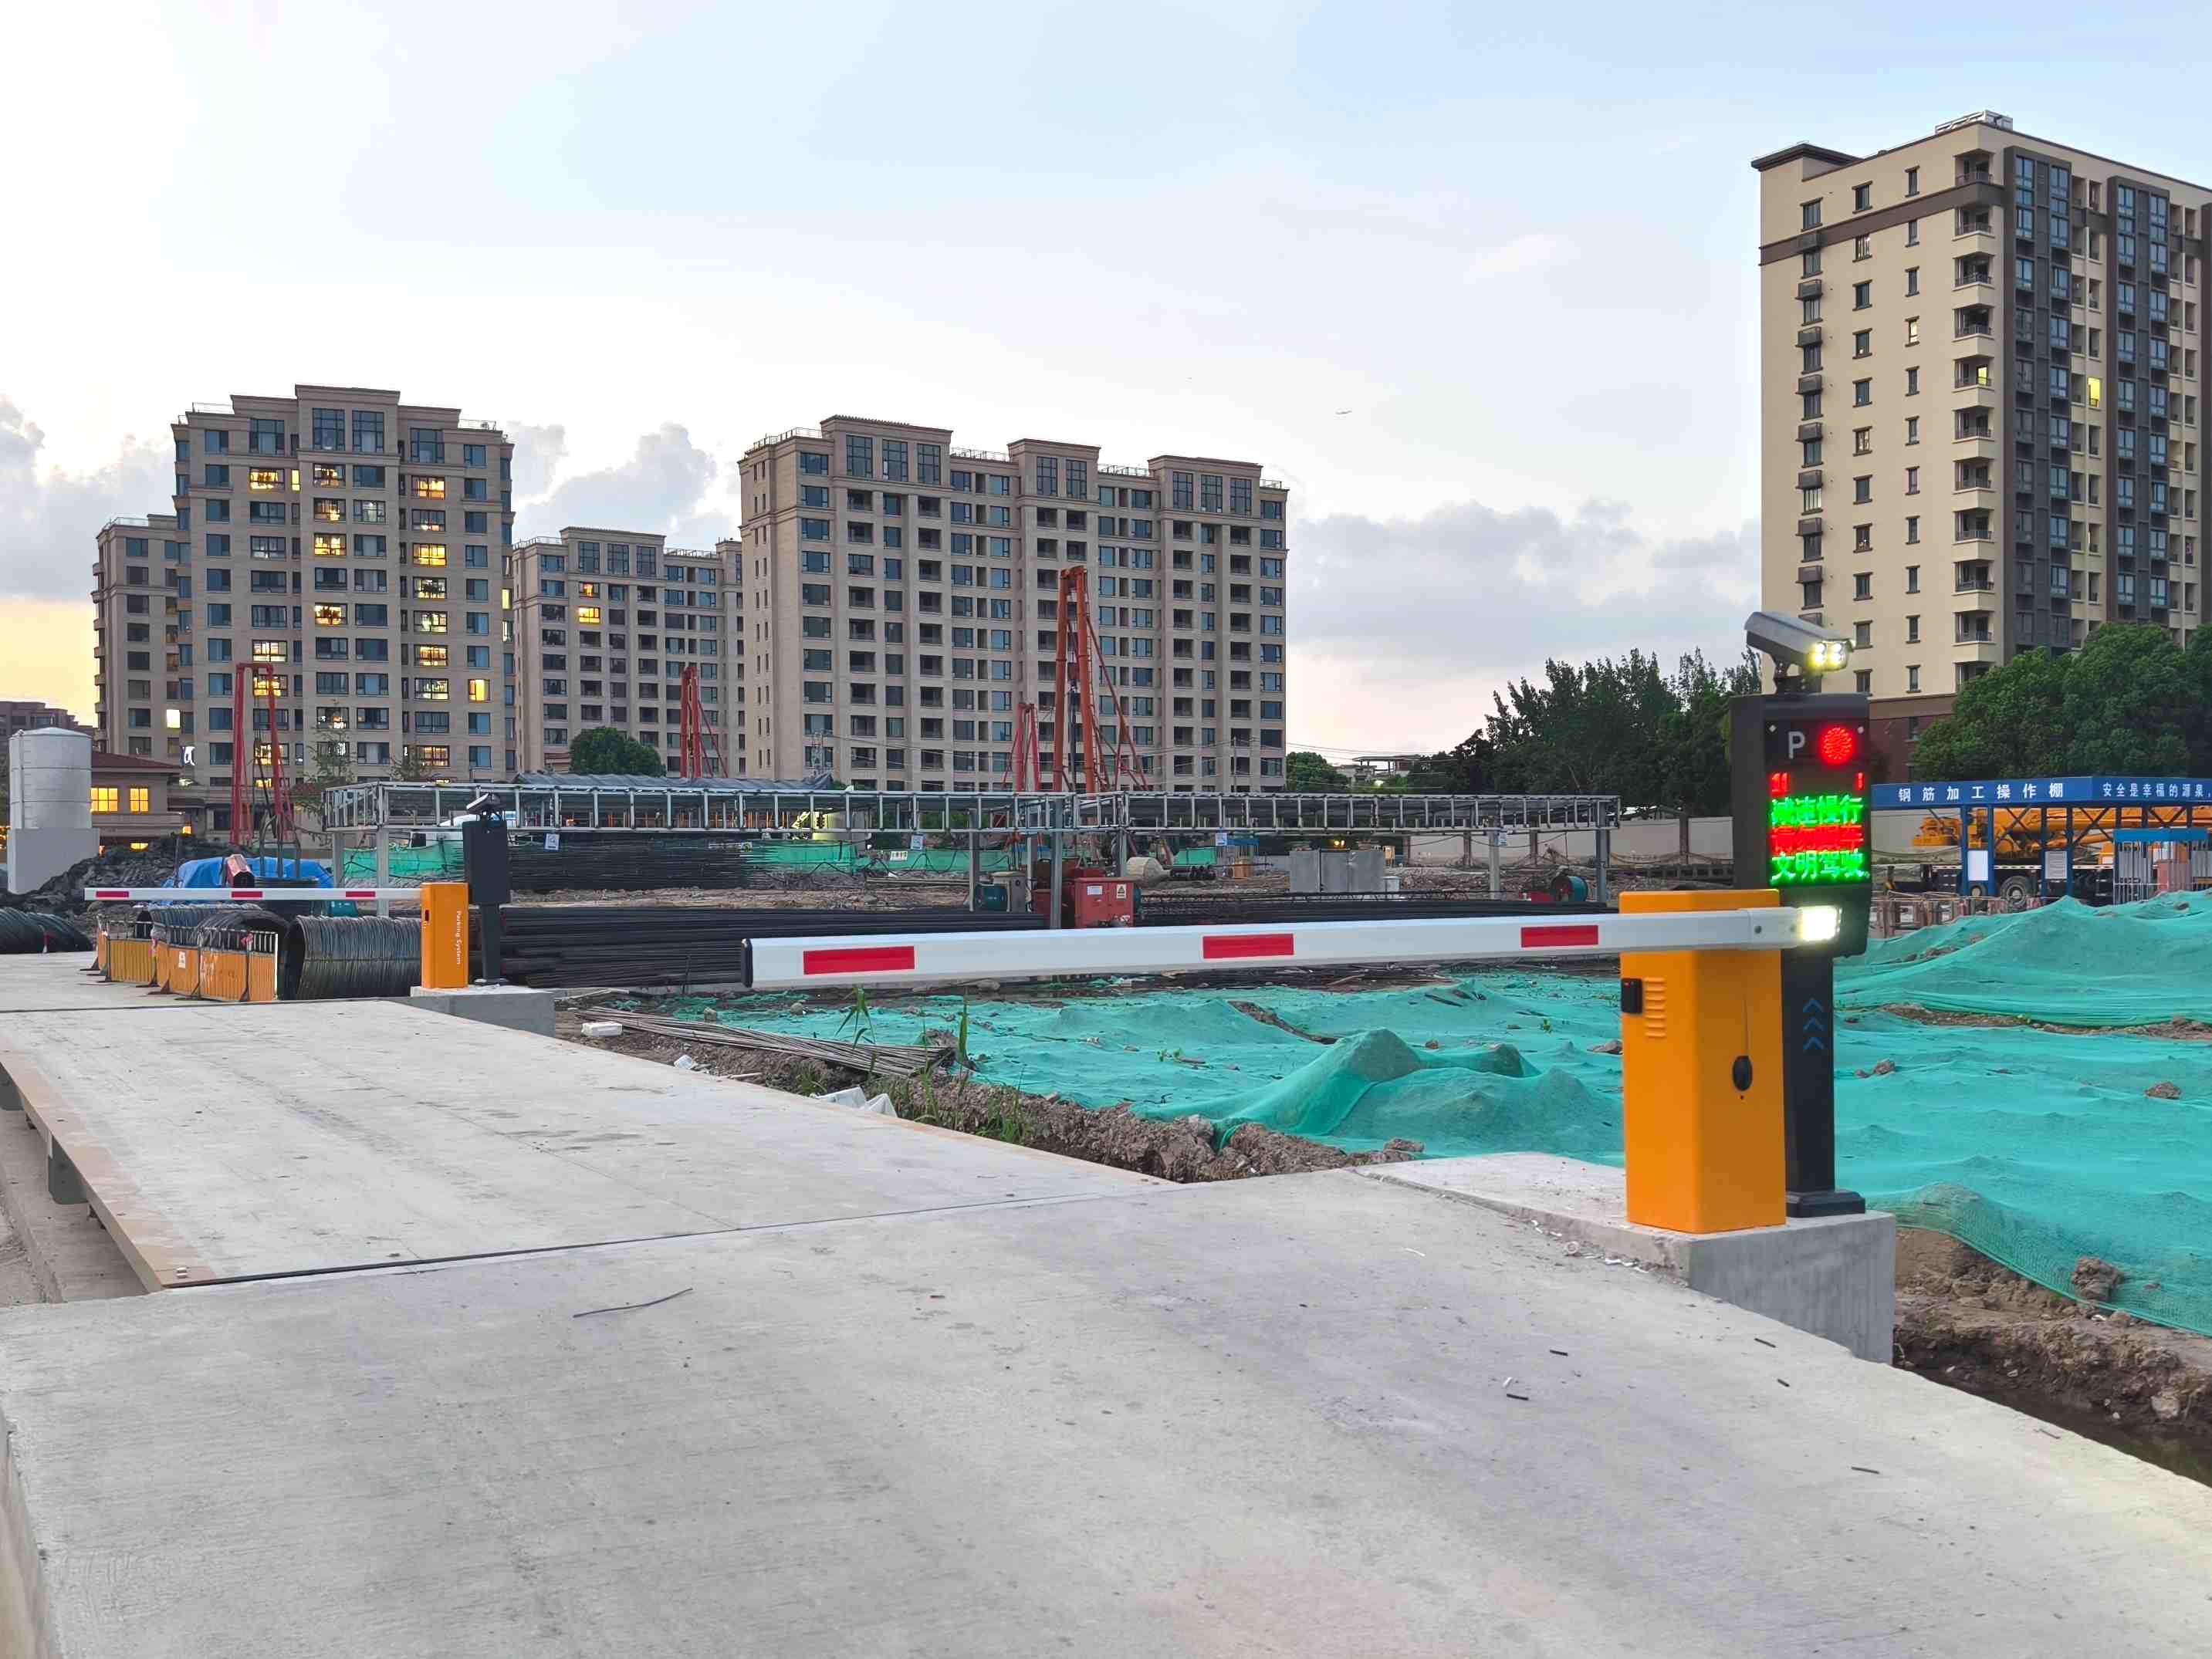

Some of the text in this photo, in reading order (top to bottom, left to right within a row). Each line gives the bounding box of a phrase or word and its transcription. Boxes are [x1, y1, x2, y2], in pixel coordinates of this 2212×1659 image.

[1788, 731, 1806, 759] P
[1898, 782, 2064, 802] 钢筋加工操作棚
[1771, 795, 1864, 825] 减速慢行
[1770, 848, 1865, 882] 文明驾驶
